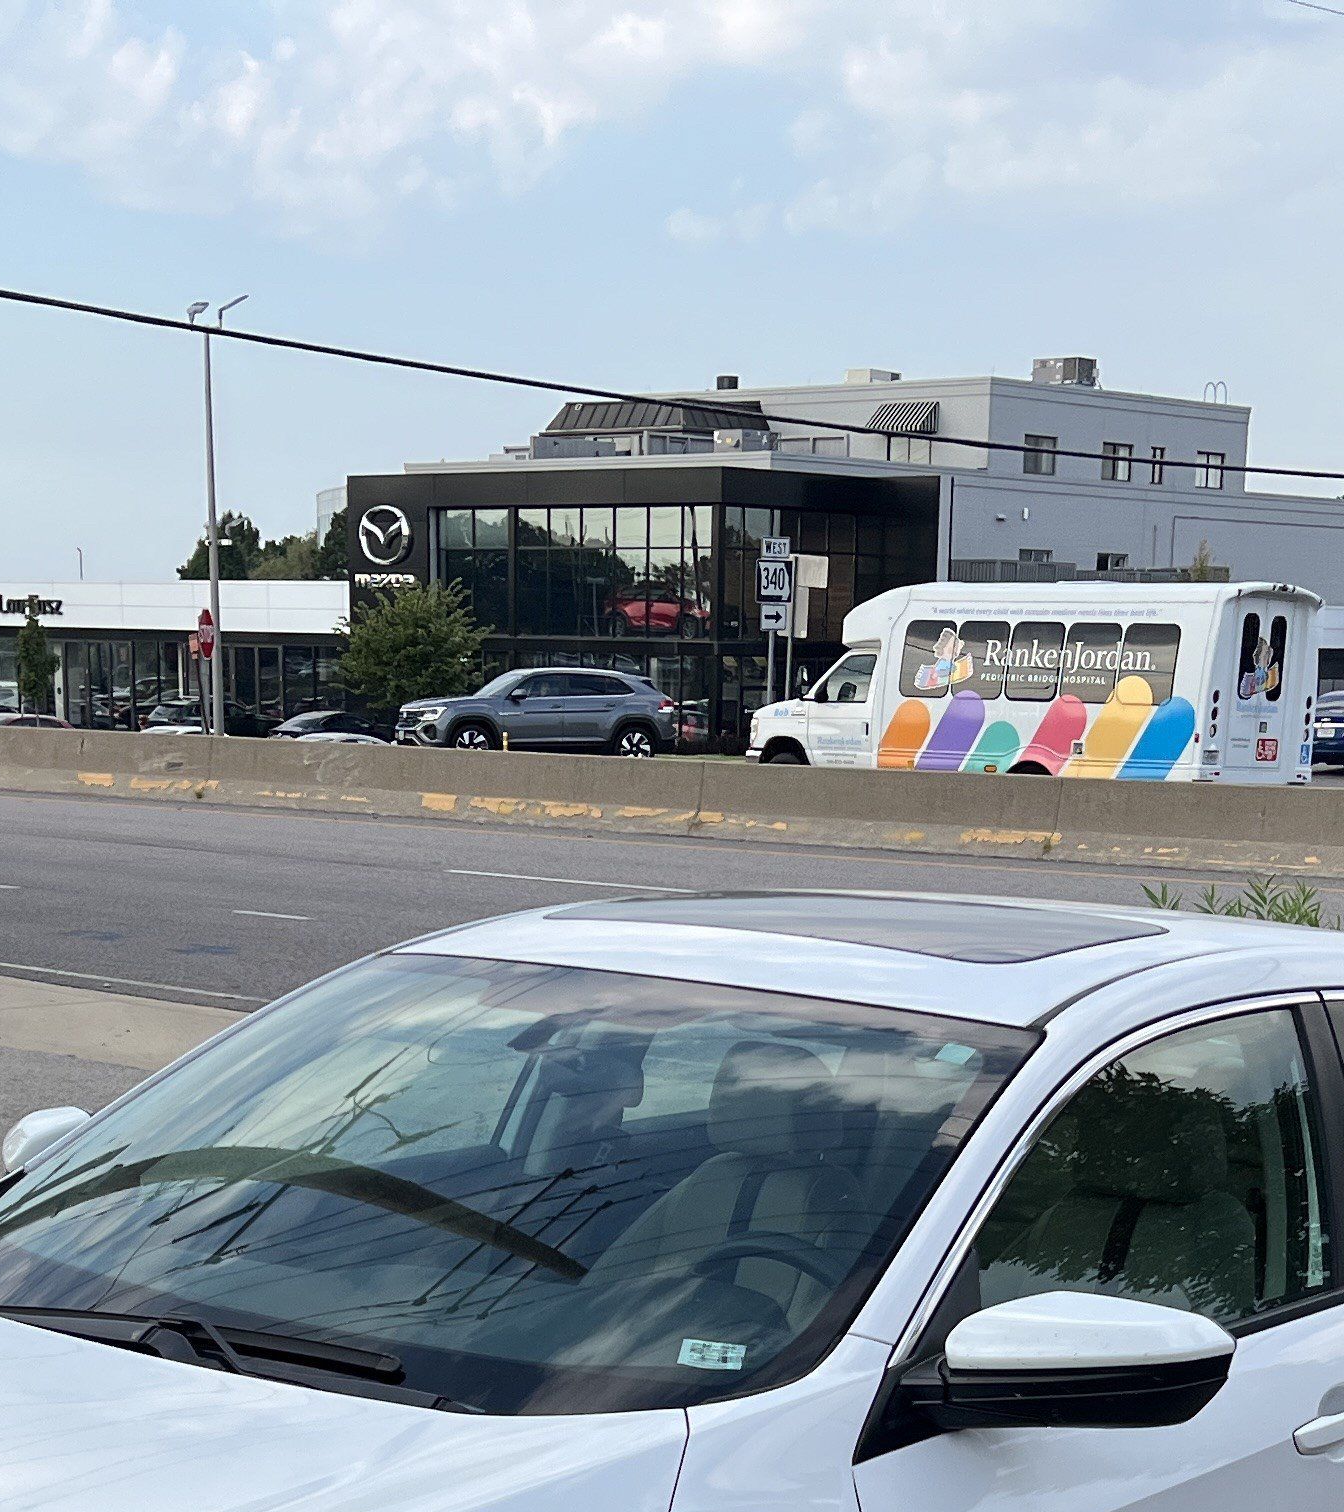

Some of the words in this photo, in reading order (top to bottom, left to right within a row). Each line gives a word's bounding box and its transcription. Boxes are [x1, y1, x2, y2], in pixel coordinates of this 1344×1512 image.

[765, 540, 787, 555] WEST
[354, 573, 415, 588] mazda
[762, 566, 785, 590] 340
[1062, 675, 1106, 685] HOSPITAL
